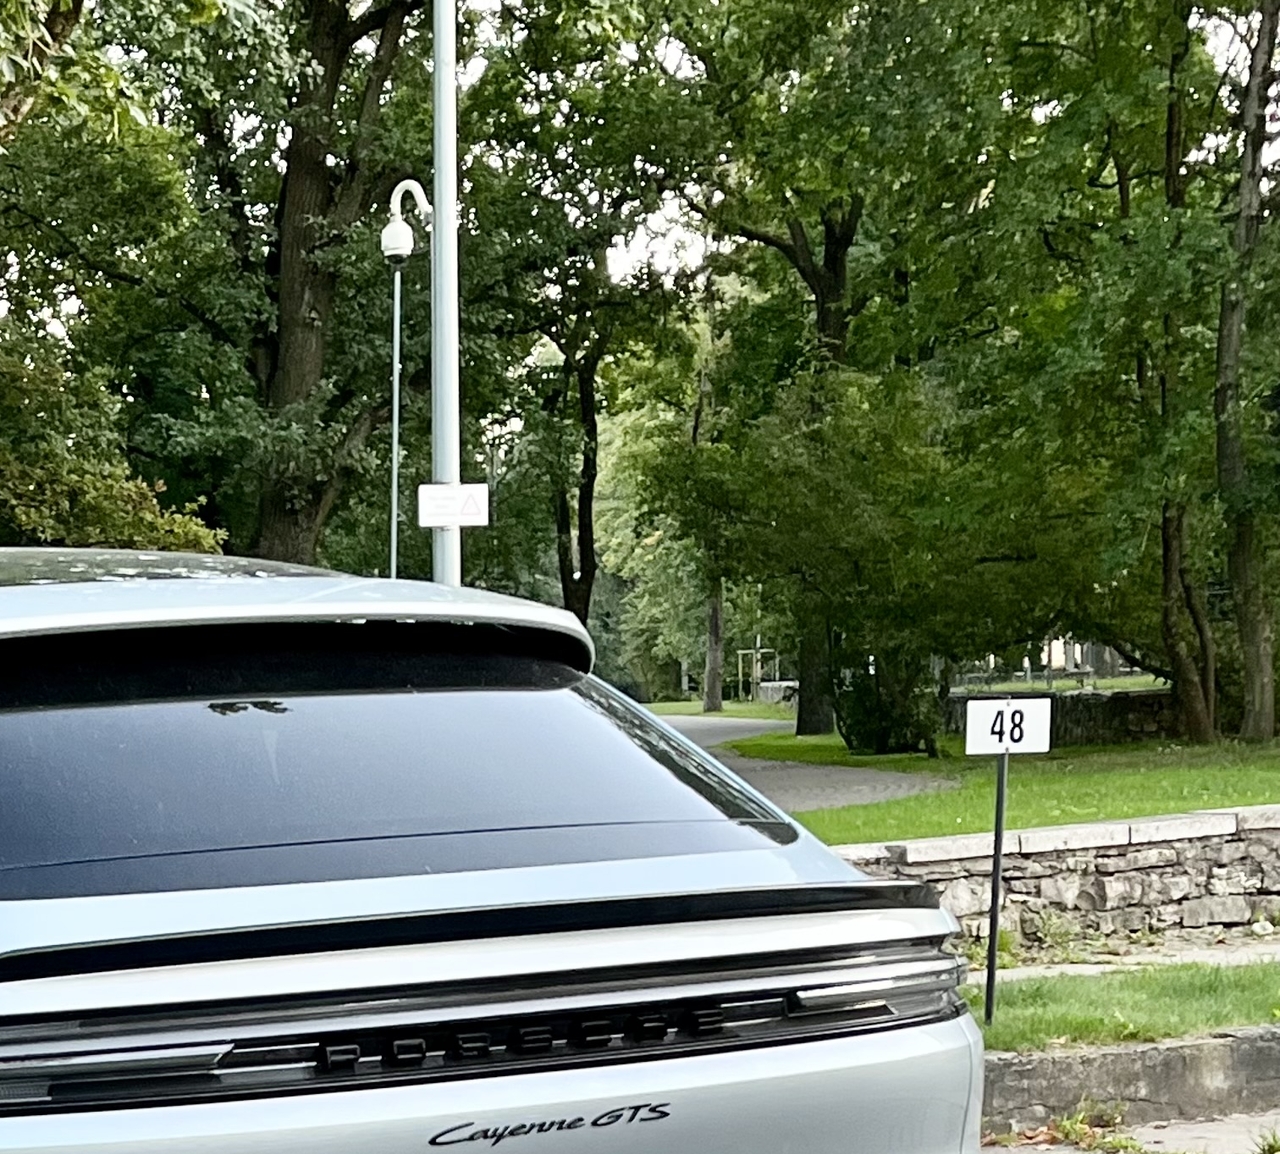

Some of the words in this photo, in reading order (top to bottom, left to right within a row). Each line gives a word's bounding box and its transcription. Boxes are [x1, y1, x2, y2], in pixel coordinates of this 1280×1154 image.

[990, 709, 1024, 743] 48
[428, 1116, 586, 1146] Cayenne
[591, 1102, 671, 1127] GTS
